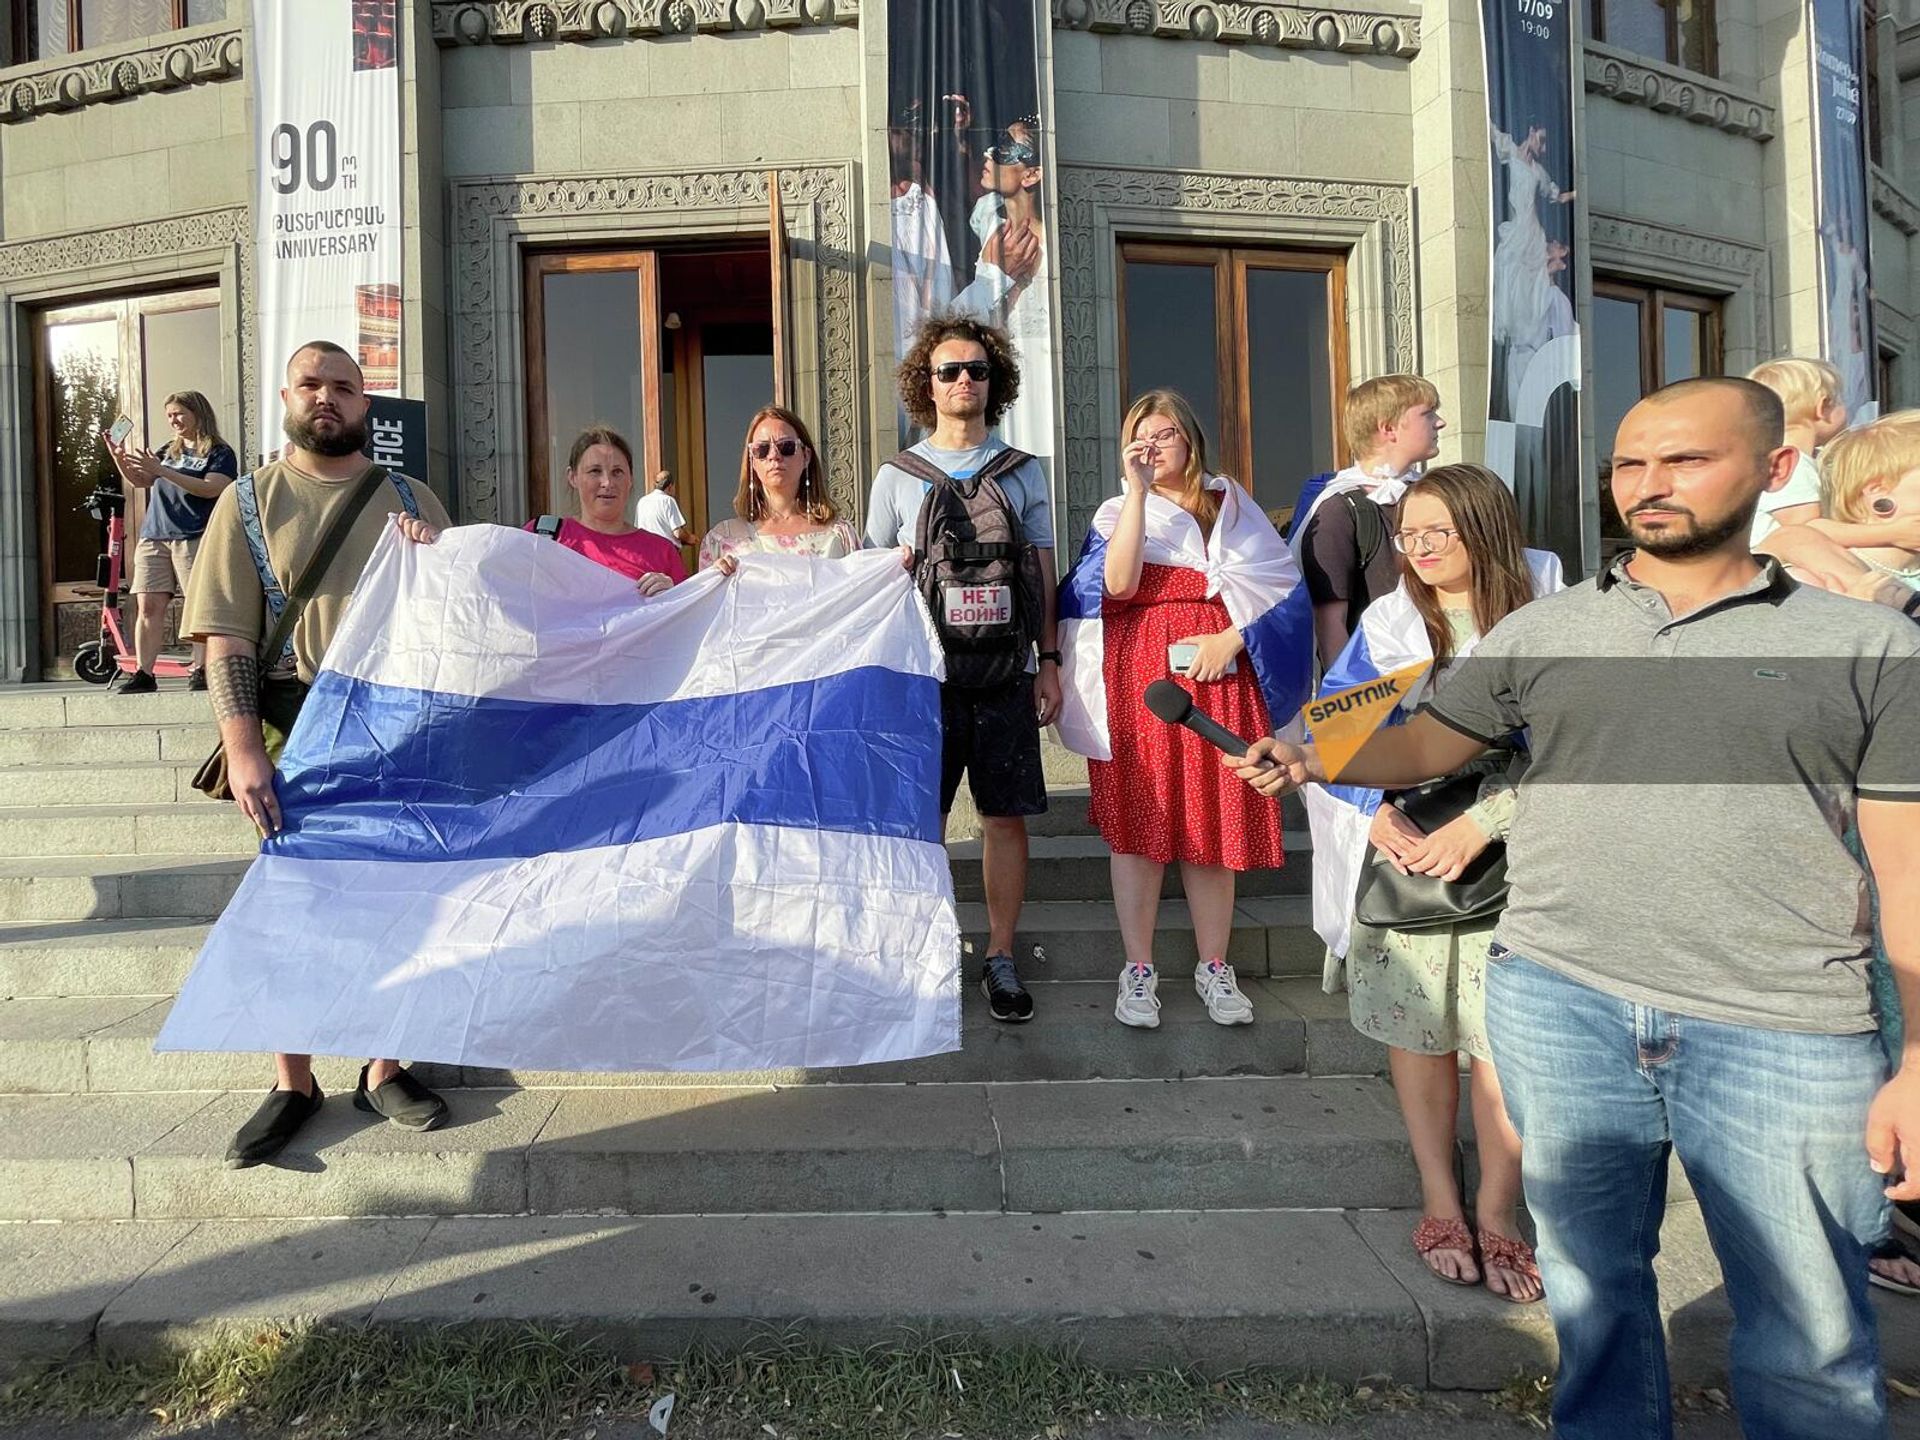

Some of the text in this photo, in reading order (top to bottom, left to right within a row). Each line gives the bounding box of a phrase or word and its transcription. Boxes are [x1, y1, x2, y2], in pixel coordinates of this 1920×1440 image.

[1518, 0, 1553, 19] 17/09
[1521, 19, 1550, 39] 19:00
[271, 120, 337, 195] 90
[341, 174, 357, 190] TH
[274, 232, 378, 260] ANNIVERSARY
[372, 417, 404, 472] FICE
[961, 588, 1001, 605] НЕТ
[949, 605, 1009, 623] ВОЙНЕ
[1309, 678, 1400, 723] SPUTNIK
